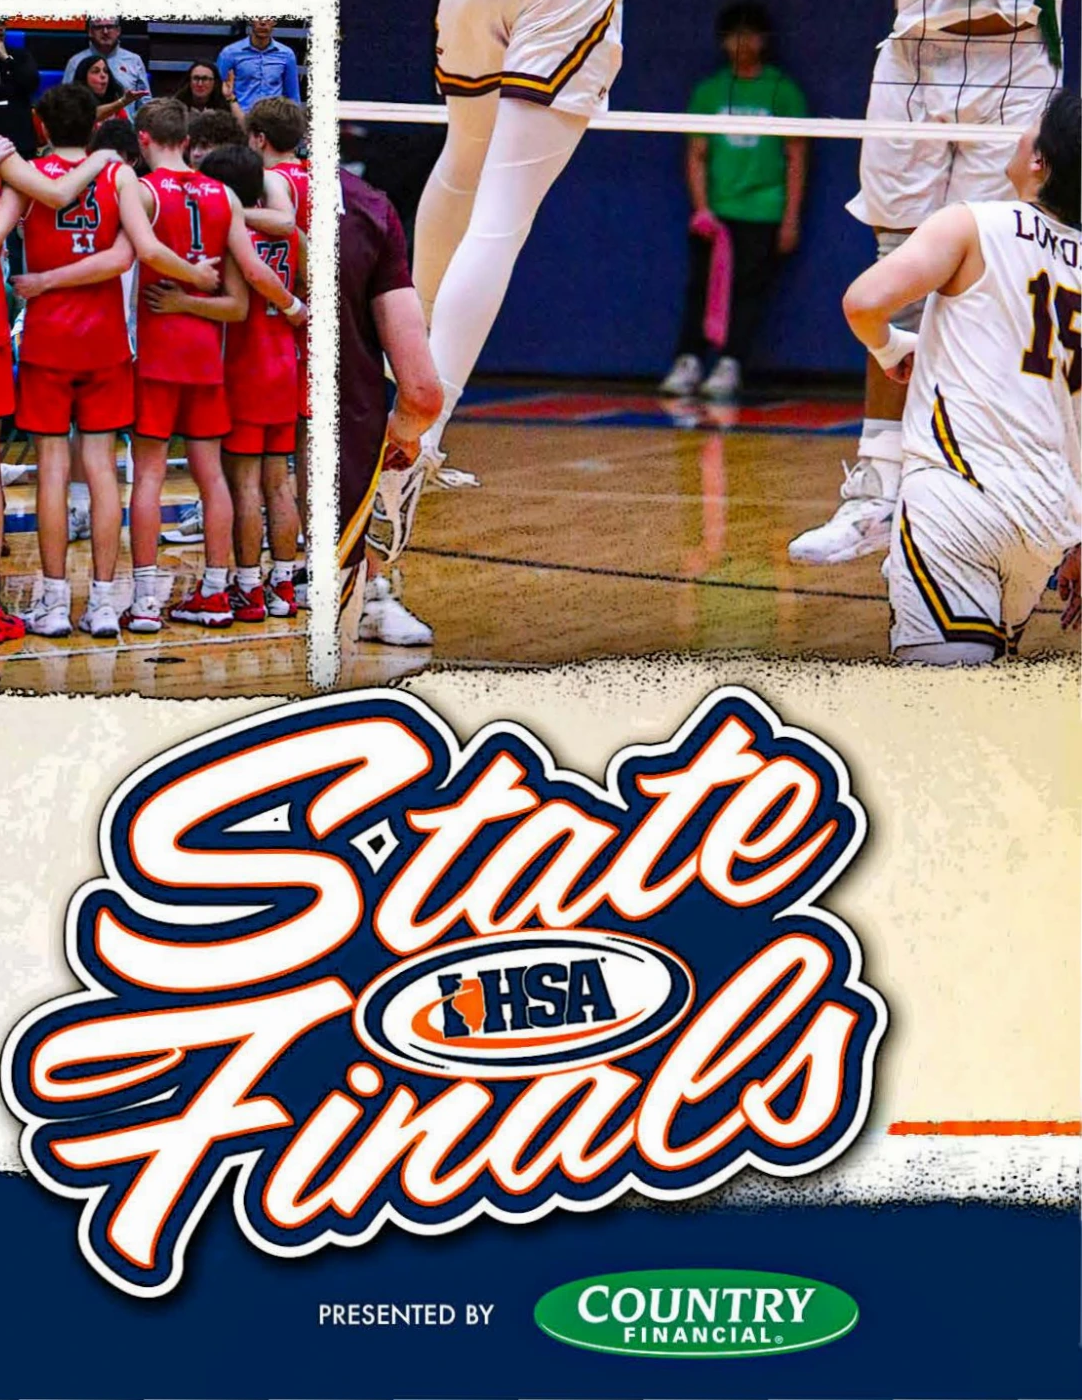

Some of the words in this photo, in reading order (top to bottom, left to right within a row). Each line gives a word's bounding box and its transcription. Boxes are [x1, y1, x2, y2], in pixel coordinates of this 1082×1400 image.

[185, 197, 205, 252] 1
[96, 714, 841, 991] State
[437, 956, 617, 1046] IHSA
[30, 934, 856, 1269] Finals
[318, 1304, 456, 1325] PRESENTED
[466, 1304, 494, 1325] BY
[577, 1284, 816, 1324] COUNTRY
[624, 1327, 772, 1344] FINANCIAL
